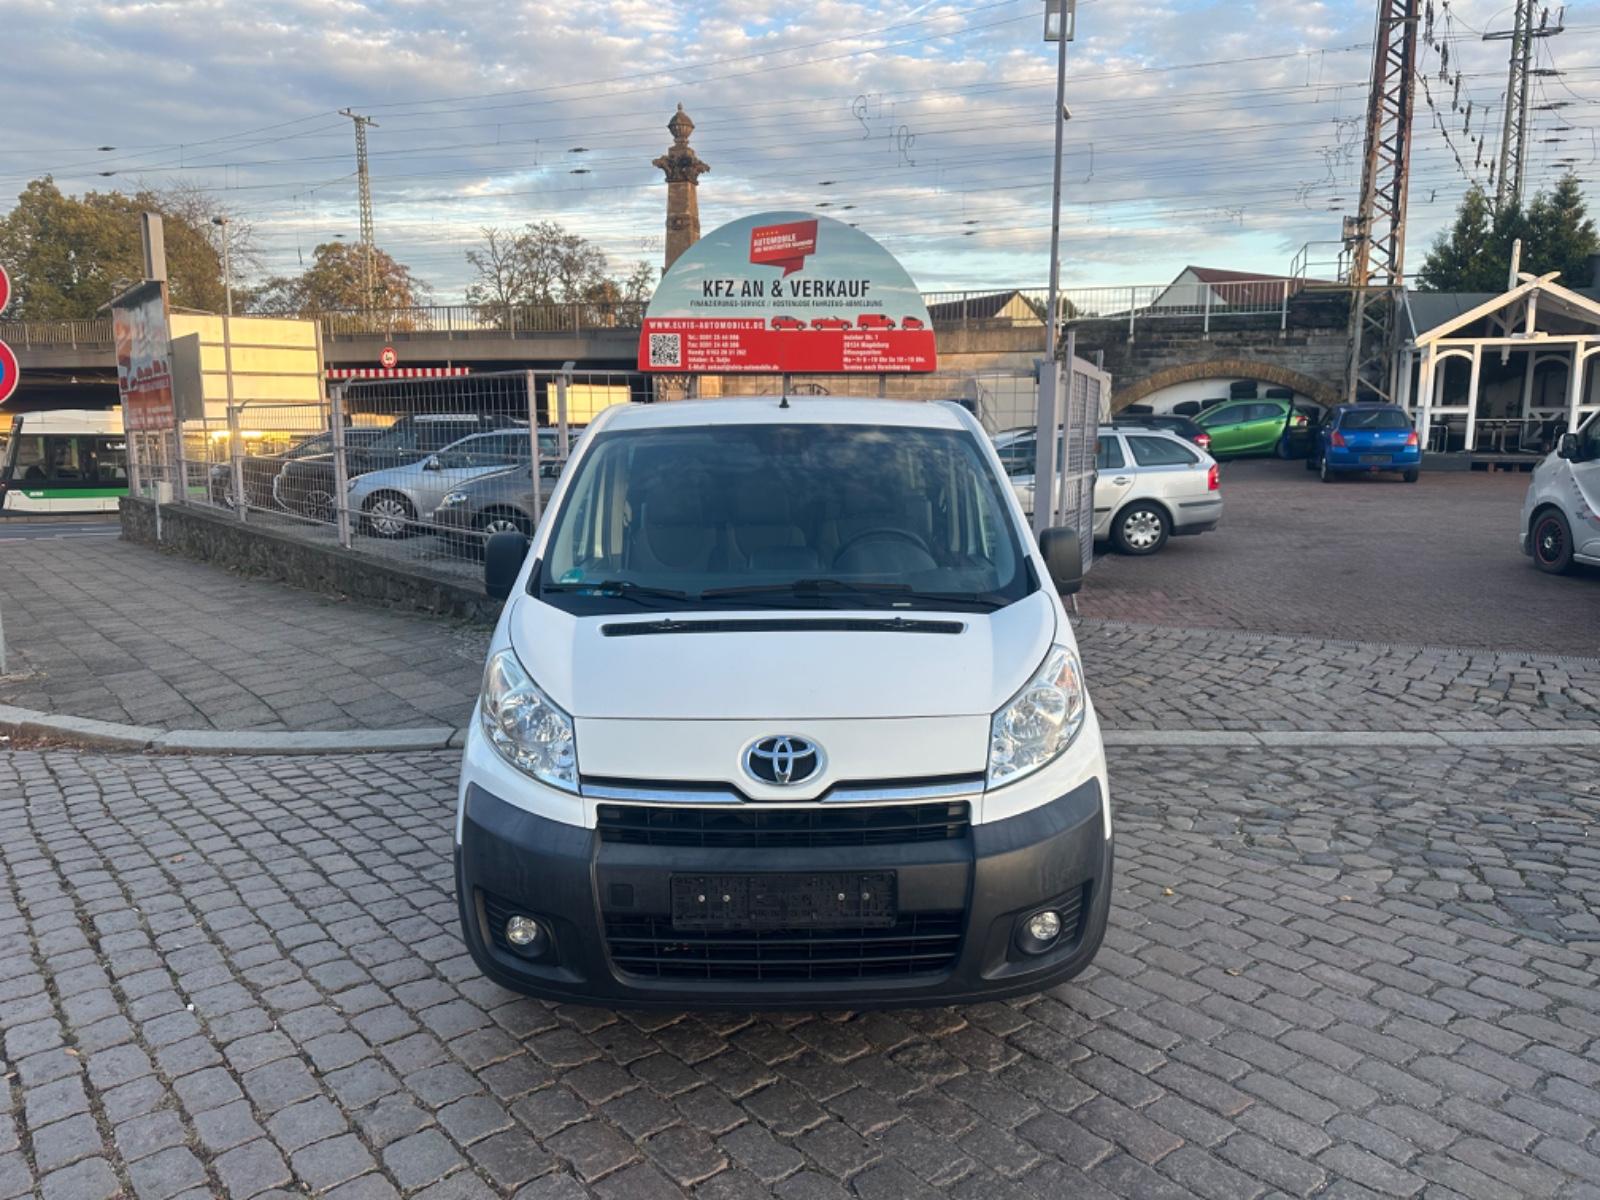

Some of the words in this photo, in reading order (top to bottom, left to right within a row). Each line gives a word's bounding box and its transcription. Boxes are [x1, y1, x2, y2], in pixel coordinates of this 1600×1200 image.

[753, 233, 796, 246] AUTOMOBILE
[703, 280, 734, 297] KFZ
[741, 280, 764, 297] AN
[771, 280, 783, 297] &
[790, 280, 870, 297] VERKAUF
[649, 321, 764, 330] WWW.ELVIS-AUTOMOBILE.DE
